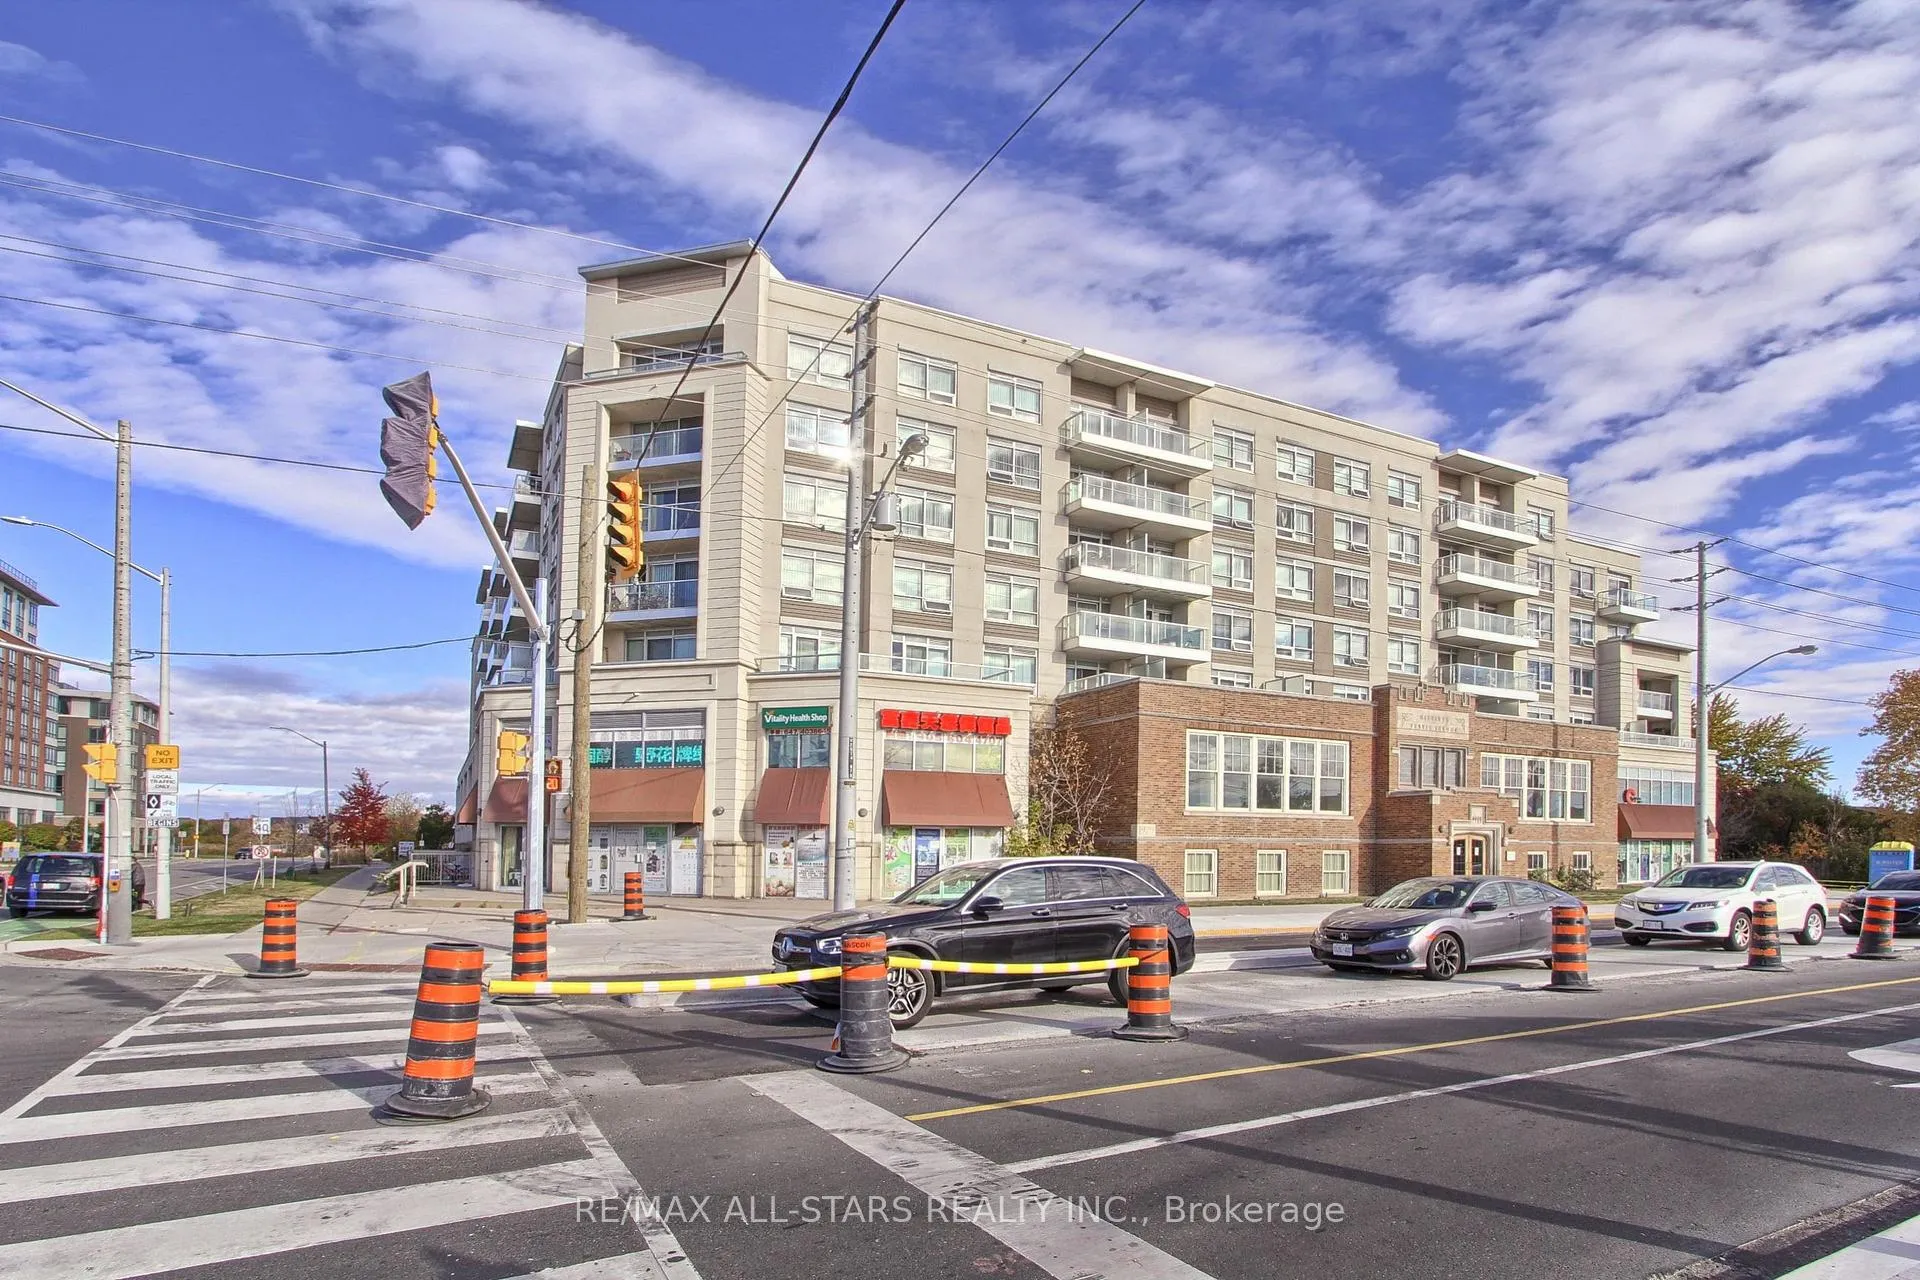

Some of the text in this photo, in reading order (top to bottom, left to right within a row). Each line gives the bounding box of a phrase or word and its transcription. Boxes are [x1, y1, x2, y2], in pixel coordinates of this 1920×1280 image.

[764, 711, 828, 724] Vitality Health Shop
